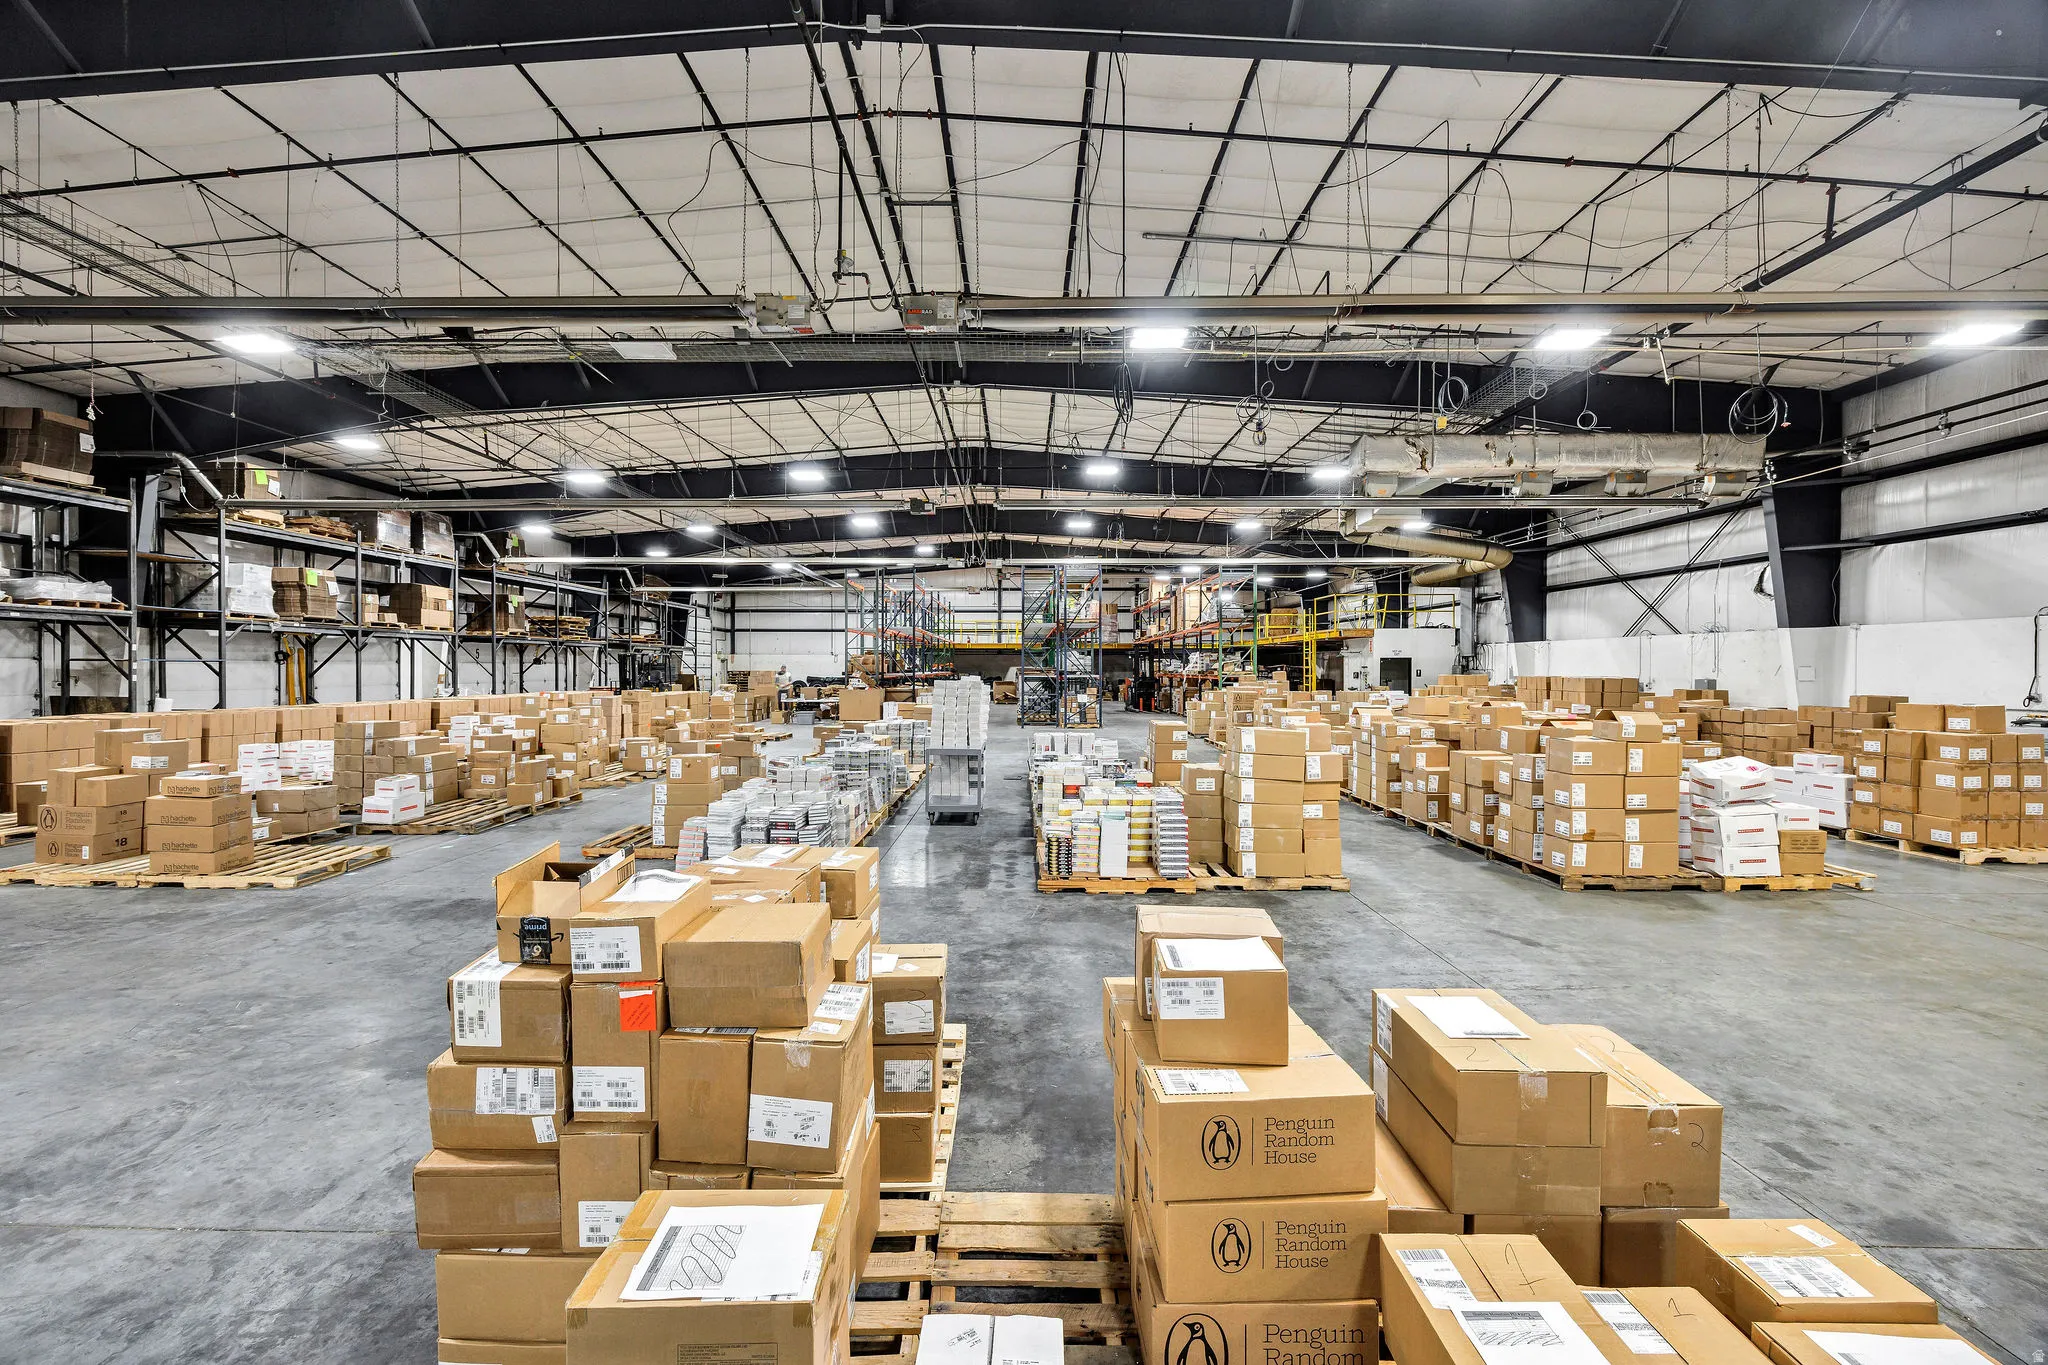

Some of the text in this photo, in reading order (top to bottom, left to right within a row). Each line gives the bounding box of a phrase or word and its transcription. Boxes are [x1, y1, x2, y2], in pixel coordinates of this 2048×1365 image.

[475, 648, 480, 659] 5
[115, 838, 128, 847] 18
[524, 923, 547, 931] prime
[1264, 1116, 1335, 1134] Penguin
[1264, 1132, 1335, 1148] Random
[1688, 1122, 1709, 1153] 2
[1264, 1150, 1317, 1165] House
[1275, 1220, 1348, 1239] Penguin
[1275, 1237, 1347, 1252] Random
[1275, 1254, 1329, 1269] House
[1262, 1323, 1366, 1348] Penguin
[1263, 1347, 1365, 1365] Random
